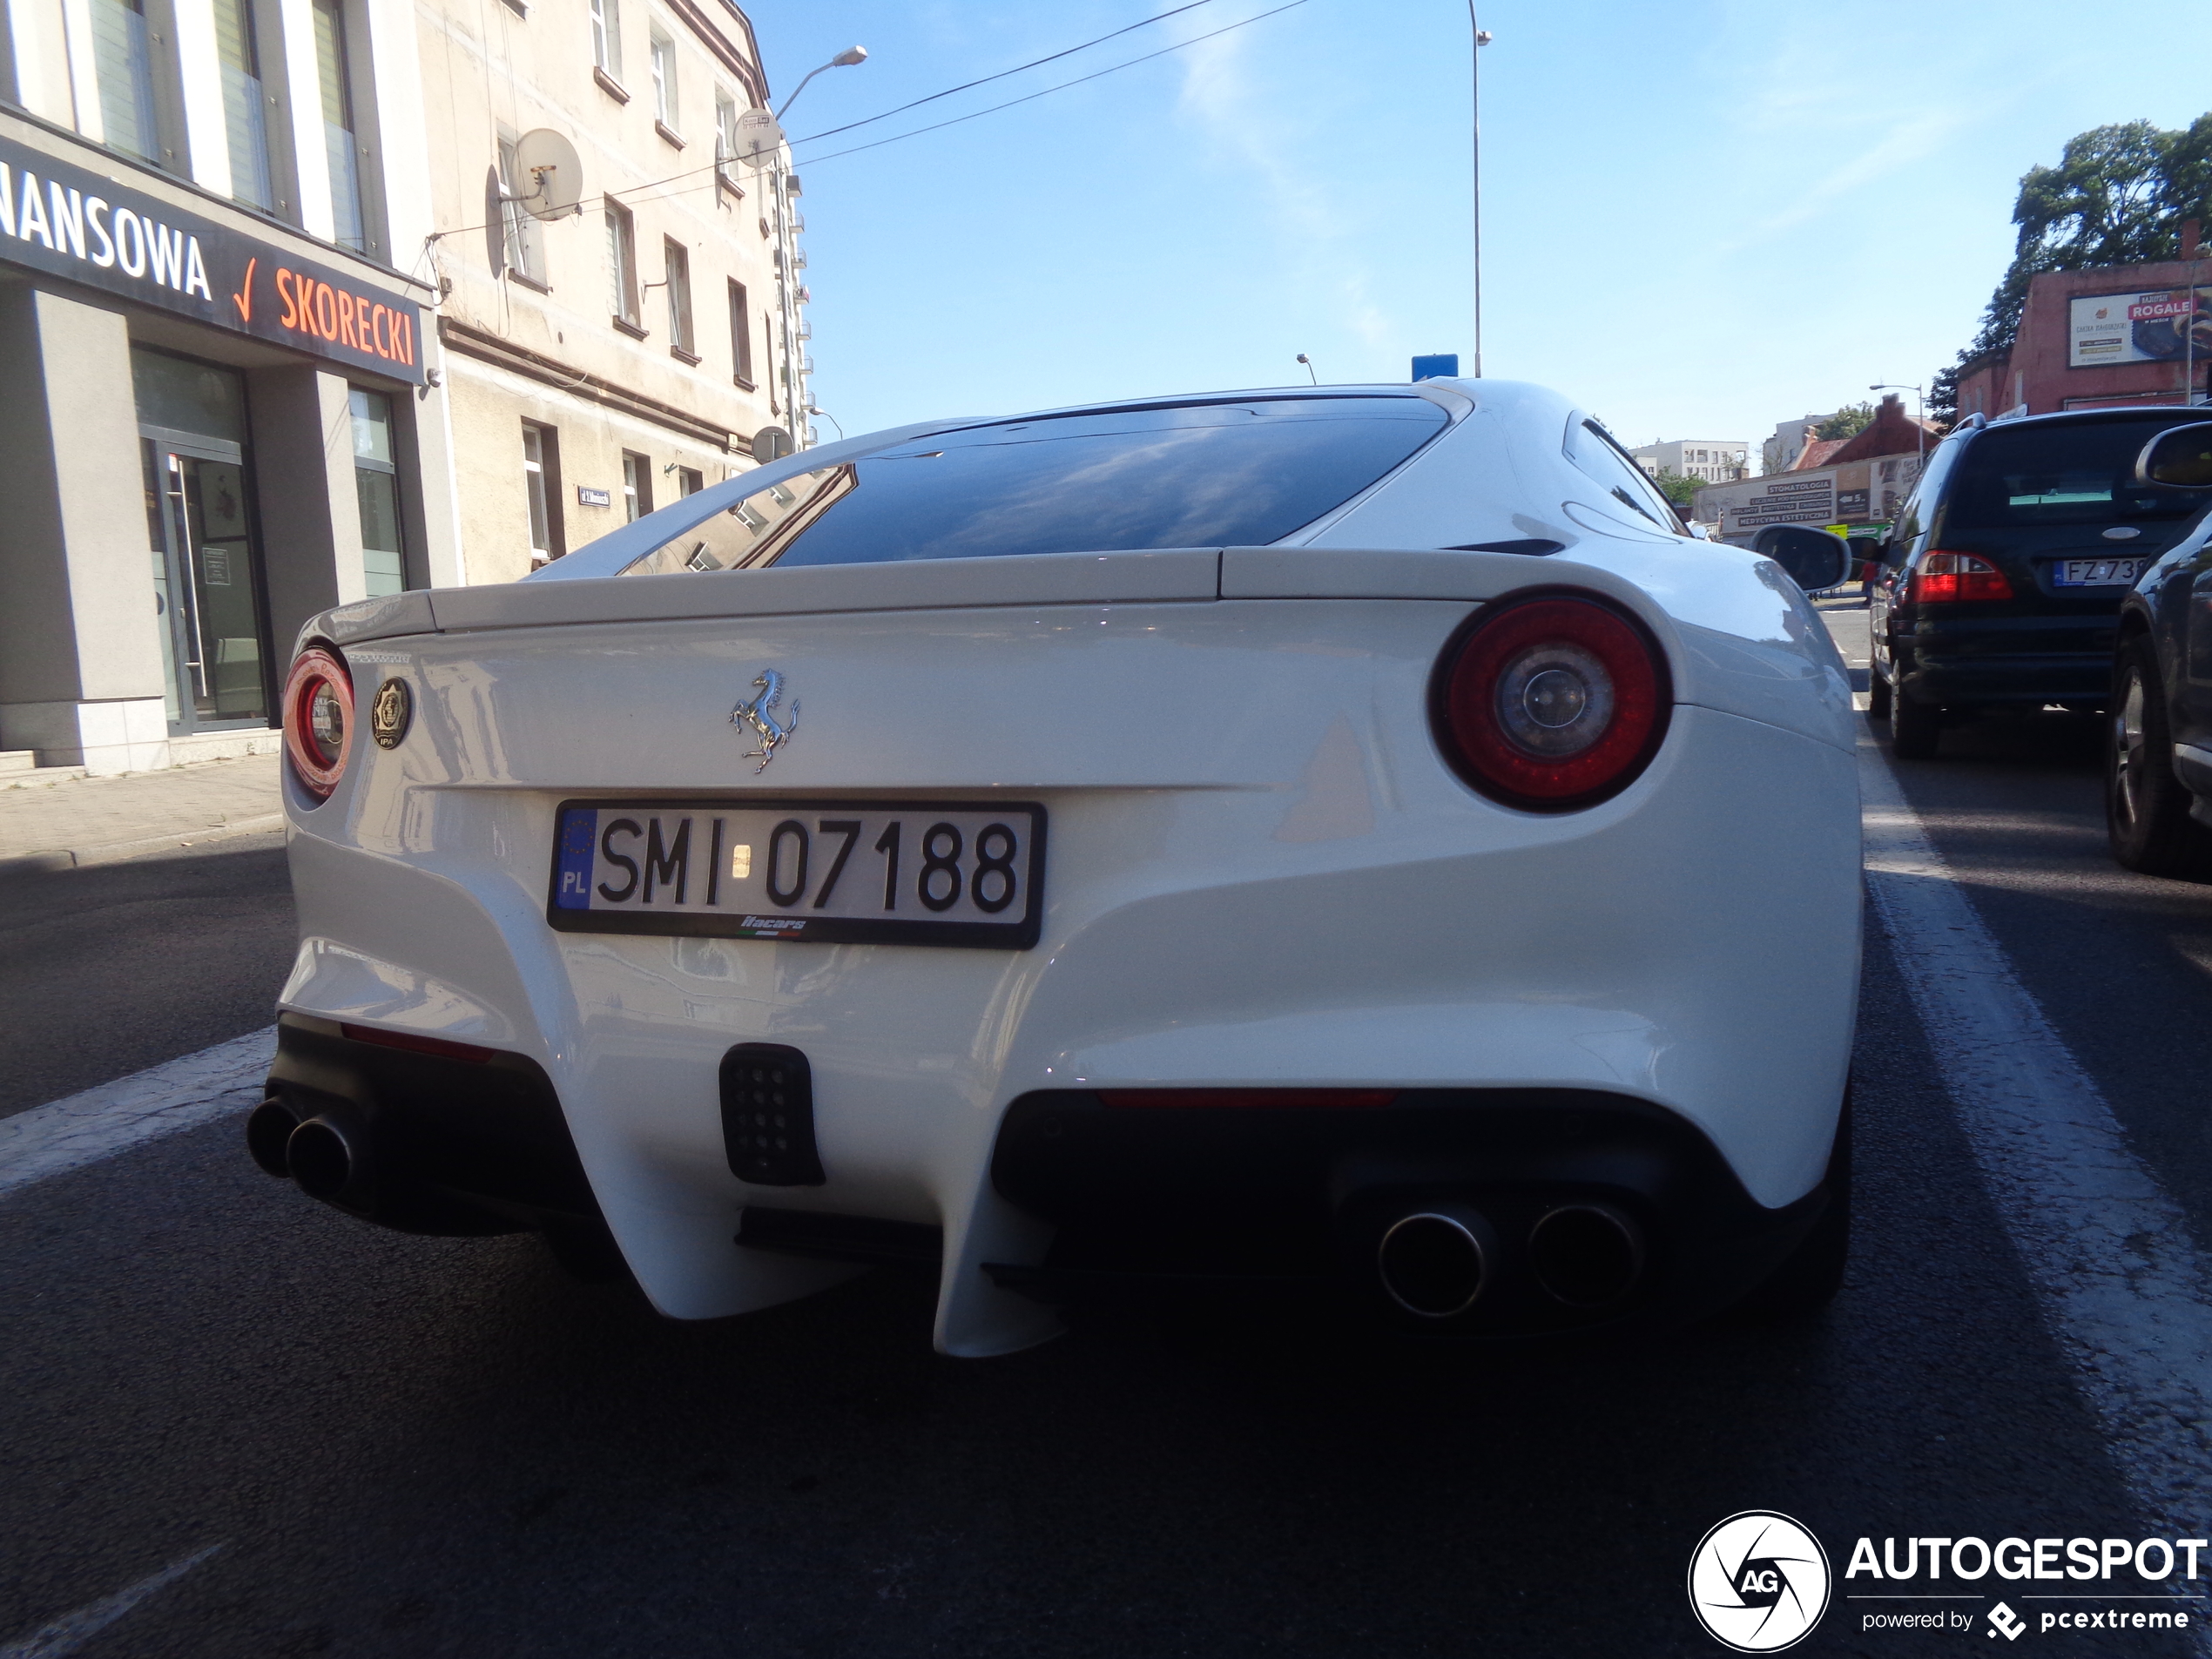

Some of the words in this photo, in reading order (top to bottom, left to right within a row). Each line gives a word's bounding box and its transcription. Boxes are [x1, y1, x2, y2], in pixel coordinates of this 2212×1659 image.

[275, 267, 413, 366] SKORECKI
[2134, 301, 2190, 316] ROGALE
[1770, 481, 1829, 493] STOMATOLOGIA
[1740, 516, 1780, 525] MEDYCYNA
[1782, 511, 1829, 521] ESTETYCZNA
[2068, 561, 2097, 580] FZ
[597, 818, 722, 905] SMI
[766, 819, 1017, 913] 07188
[563, 871, 586, 894] PL
[741, 916, 806, 929] itacars
